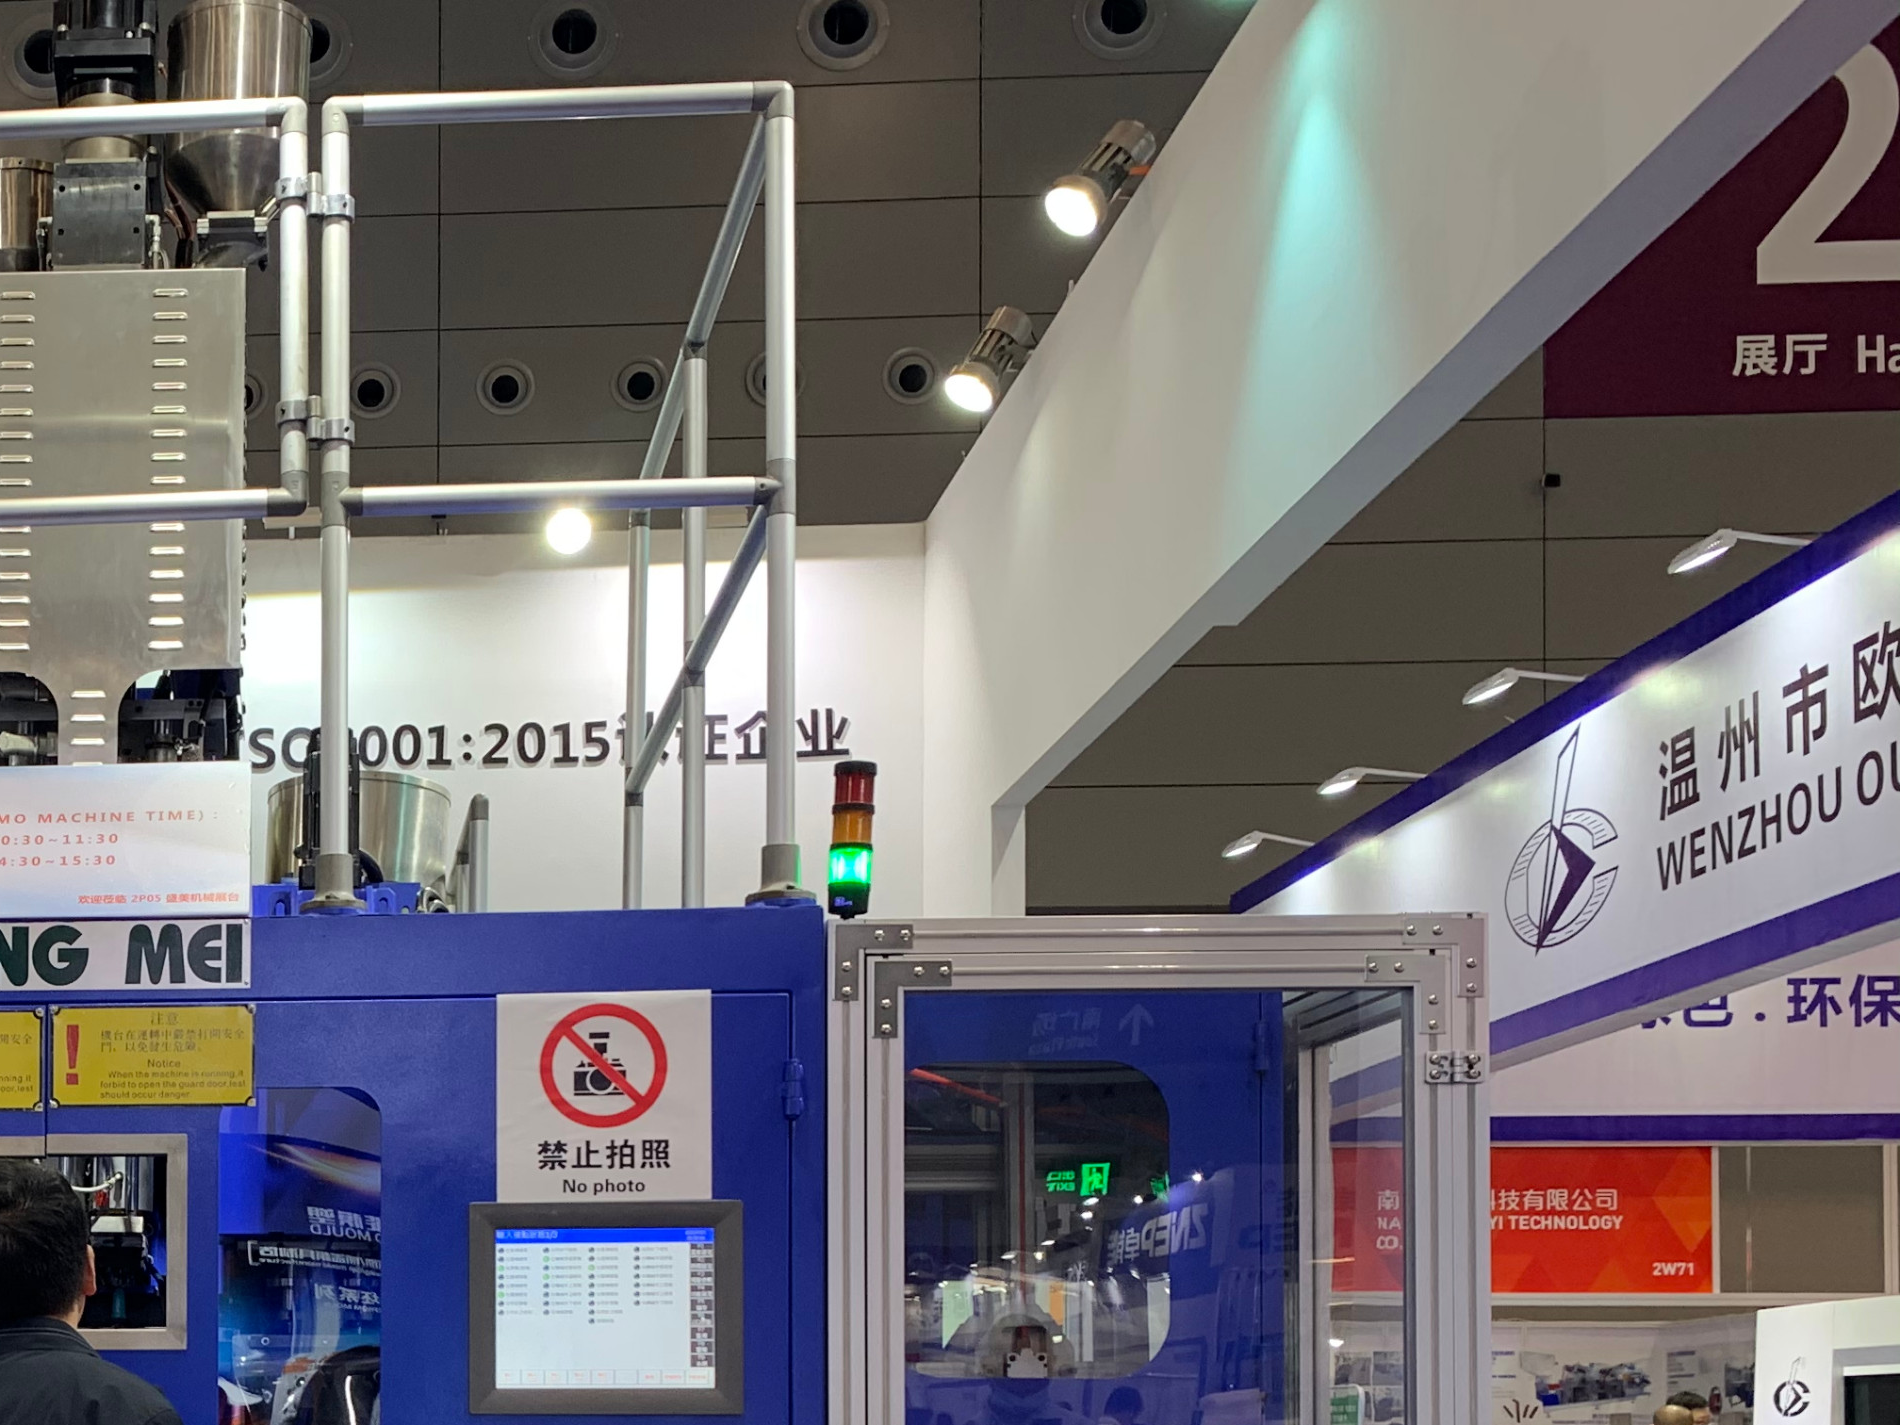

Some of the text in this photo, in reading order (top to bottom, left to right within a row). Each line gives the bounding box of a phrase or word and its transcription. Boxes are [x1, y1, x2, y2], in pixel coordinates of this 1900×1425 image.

[1732, 333, 1828, 377] 展厅
[1659, 621, 1900, 821] 温州市欧
[37, 810, 136, 824] MACHINE
[1657, 766, 1842, 891] WENZHOU
[130, 893, 162, 904] 2P05
[124, 923, 244, 986] MEI
[151, 1012, 179, 1026] 注意
[147, 1059, 181, 1069] Notice
[537, 1138, 671, 1171] 禁止拍照
[562, 1178, 646, 1196] No photo
[1490, 1188, 1619, 1212] 技有限公司
[1508, 1215, 1623, 1231] TECHNOLOGY
[1652, 1262, 1695, 1276] 2W71
